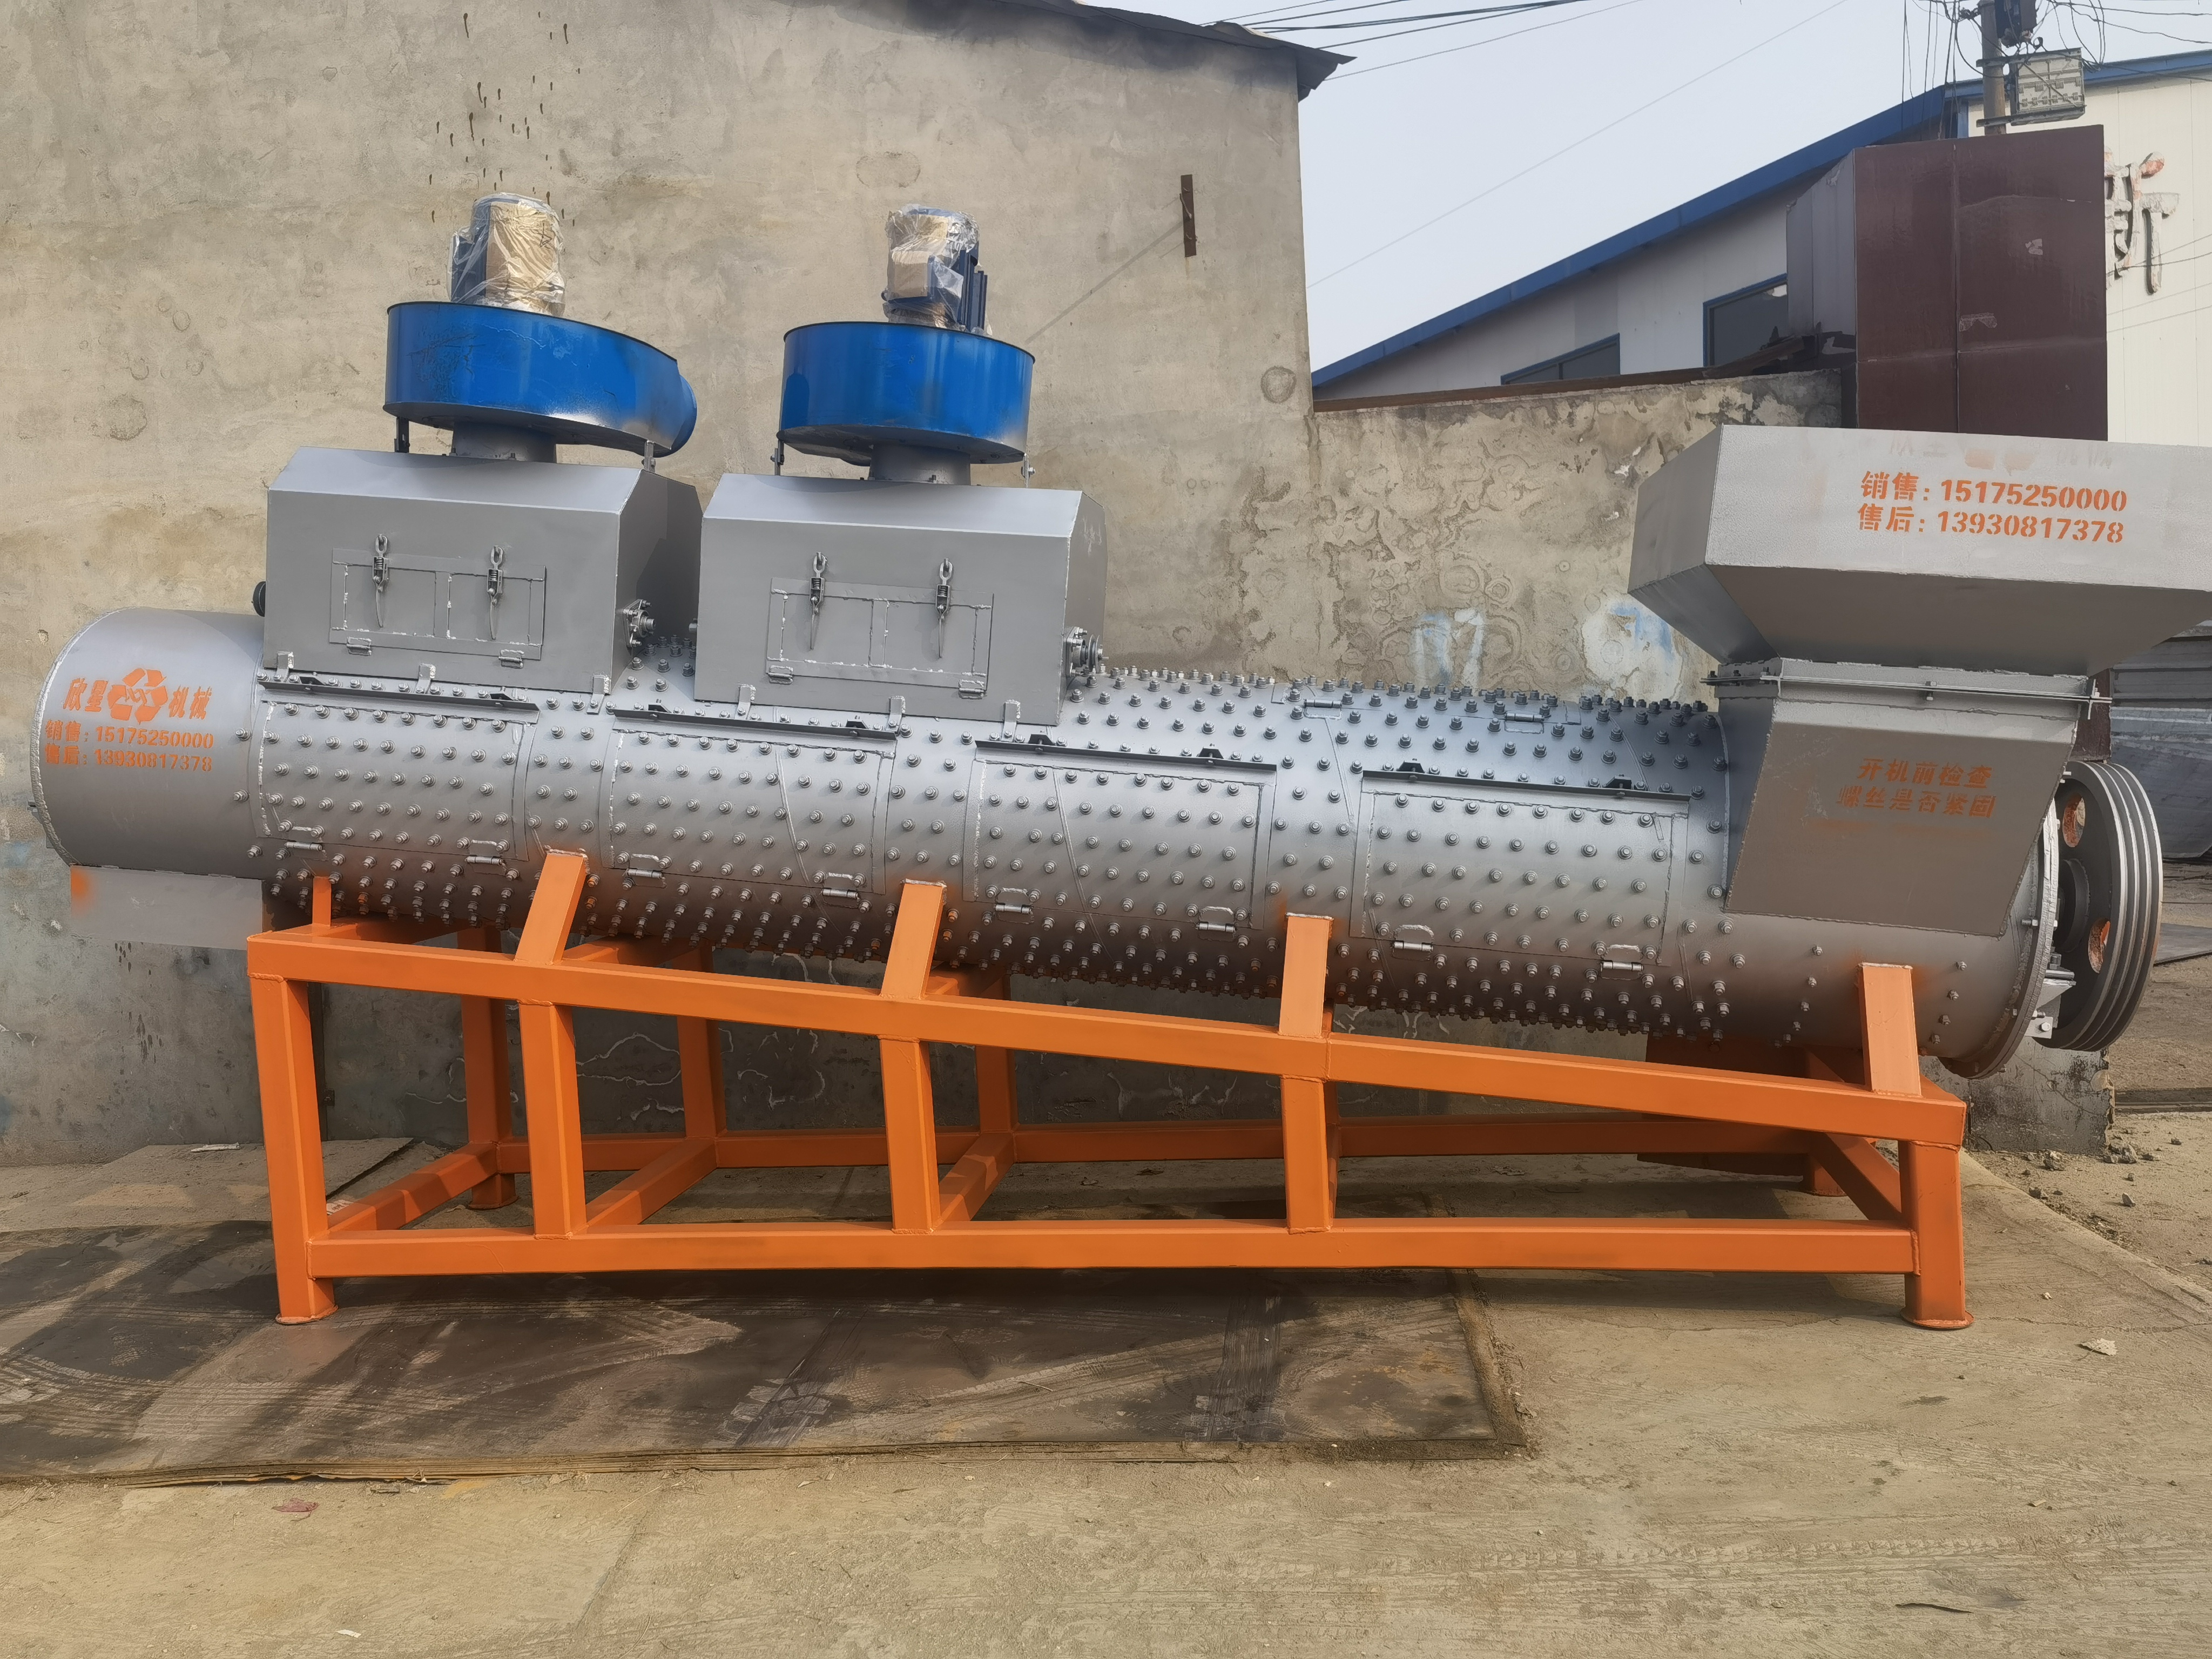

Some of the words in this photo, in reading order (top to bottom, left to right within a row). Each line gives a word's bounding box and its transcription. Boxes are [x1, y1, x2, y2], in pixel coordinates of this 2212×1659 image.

[1857, 758, 1993, 788] 开机前检查
[1836, 785, 1997, 818] 螺丝是否紧固
